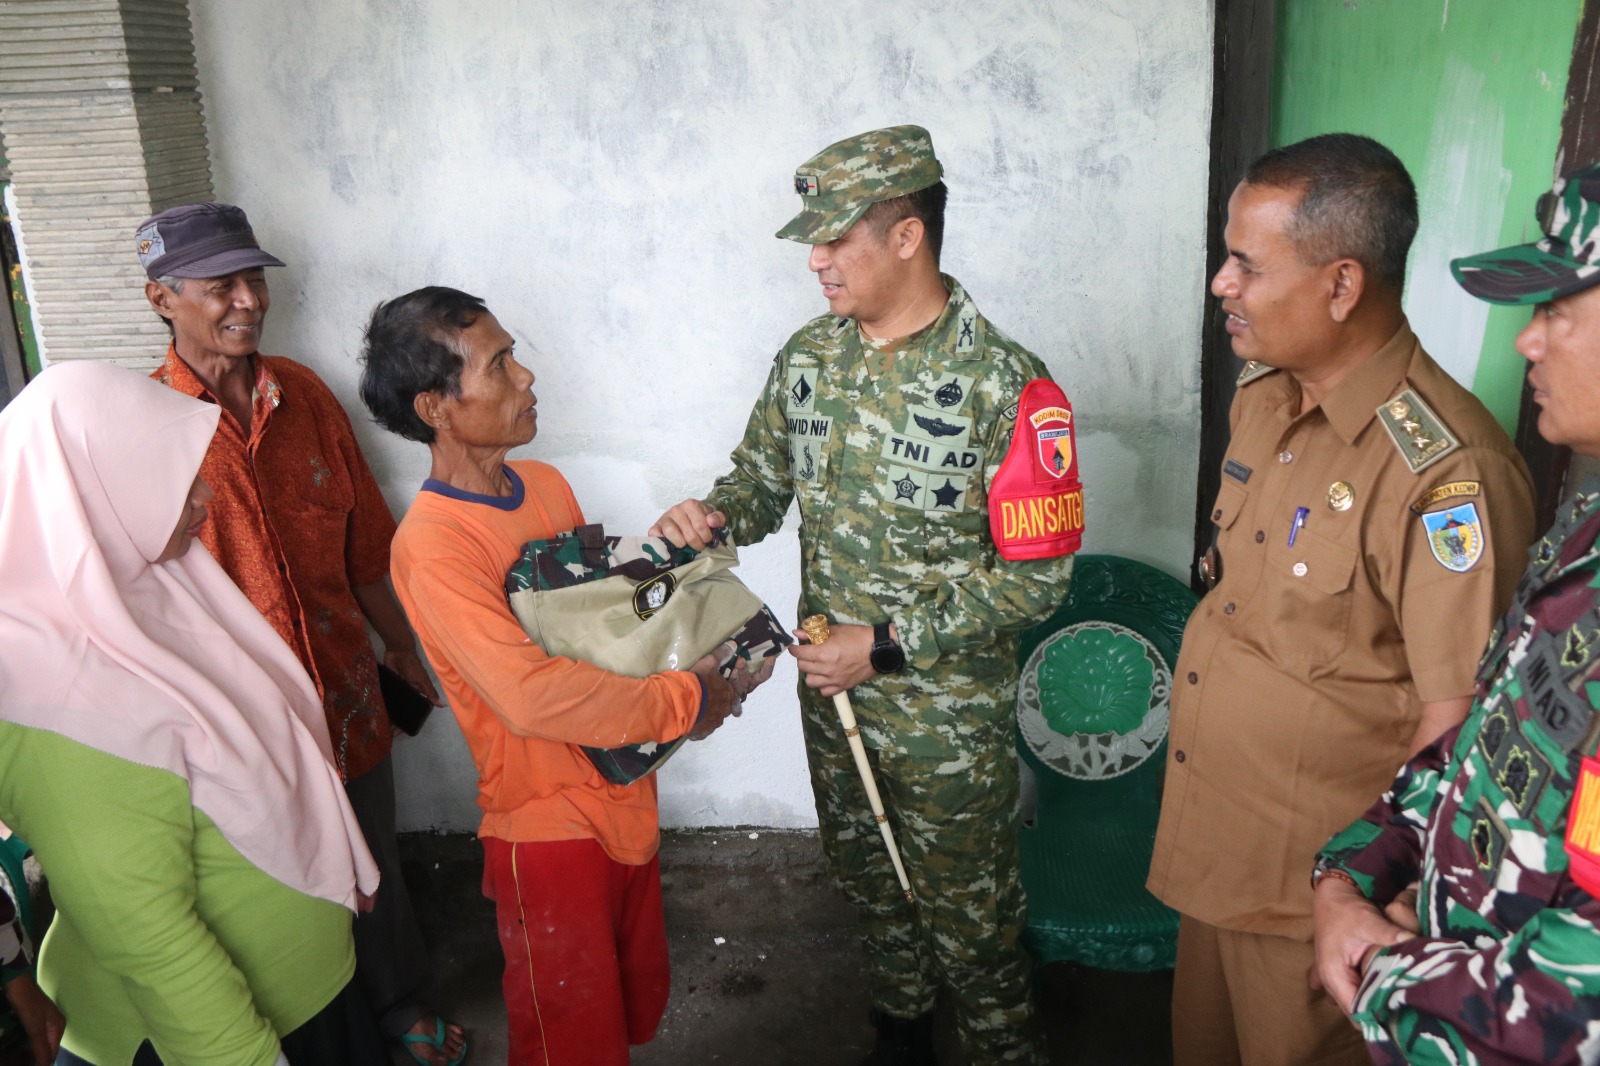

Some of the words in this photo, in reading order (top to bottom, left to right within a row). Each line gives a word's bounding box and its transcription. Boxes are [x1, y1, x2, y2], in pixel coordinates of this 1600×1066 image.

[1034, 411, 1055, 424] KODIM
[810, 419, 829, 437] NH
[891, 437, 930, 463] TNI
[940, 451, 978, 468] AD
